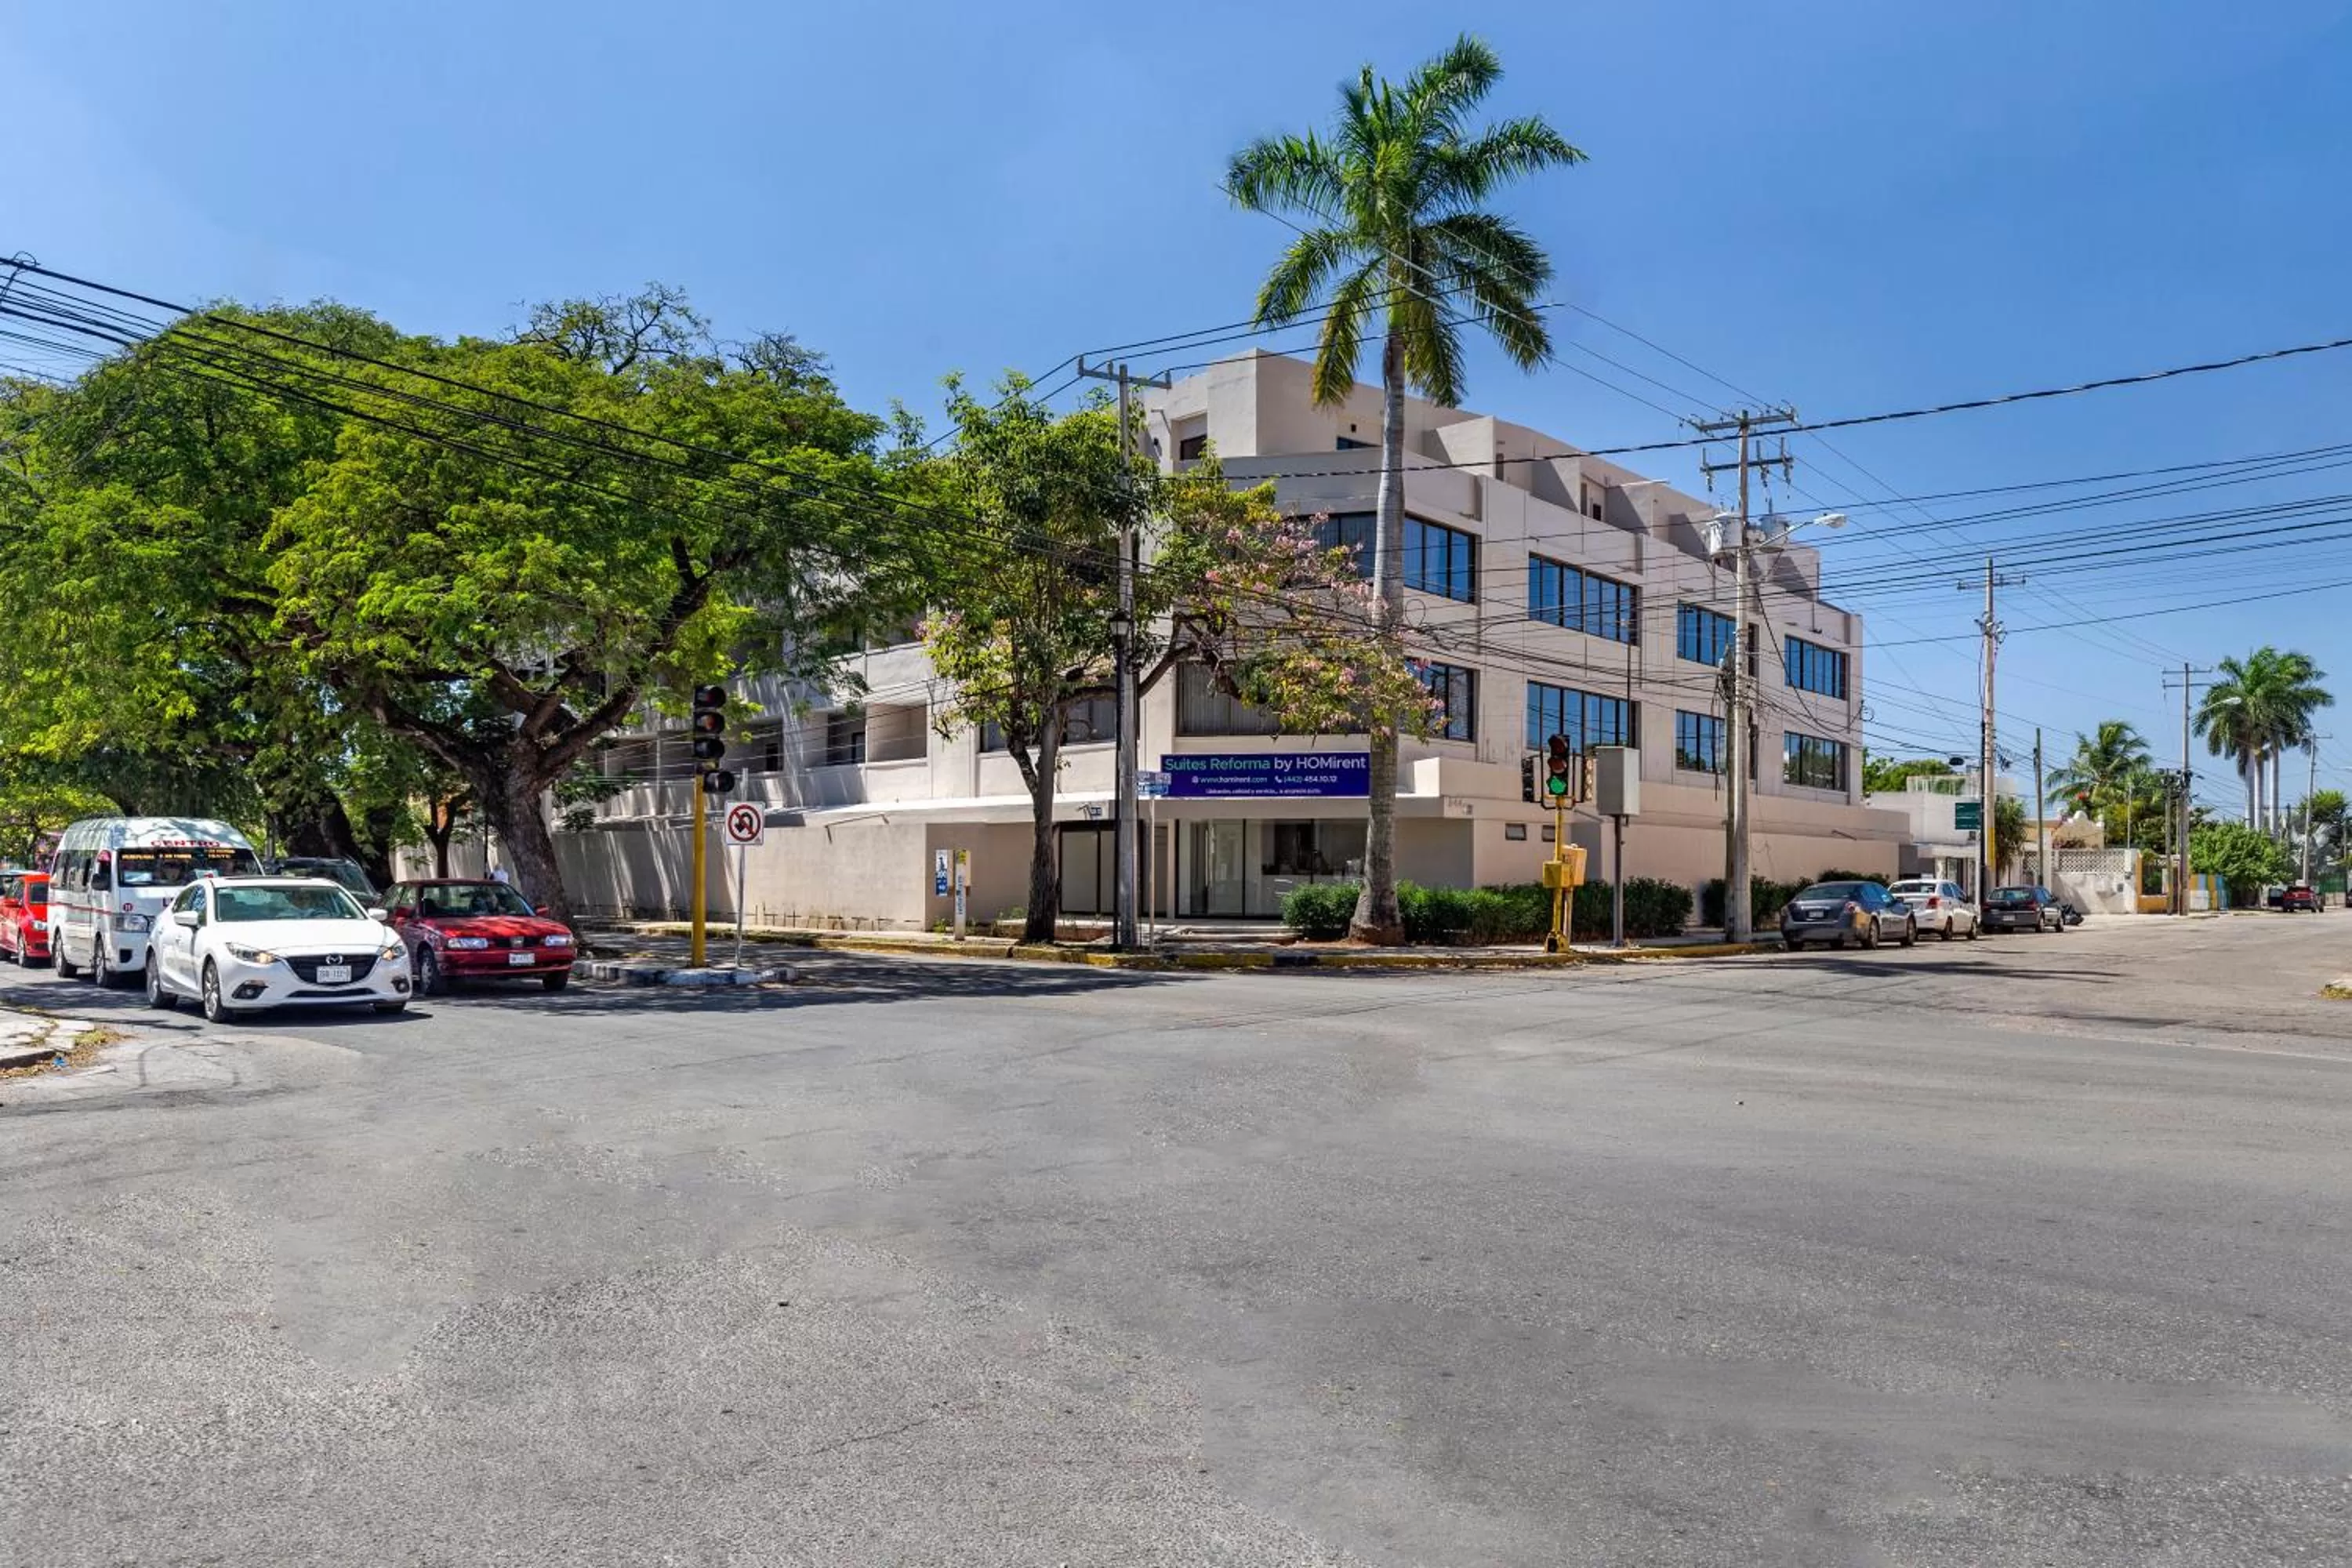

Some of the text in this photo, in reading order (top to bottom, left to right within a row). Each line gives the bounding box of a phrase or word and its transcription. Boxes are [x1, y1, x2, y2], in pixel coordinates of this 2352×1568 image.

[1164, 756, 1367, 771] Suites Reforma by HOMirent
